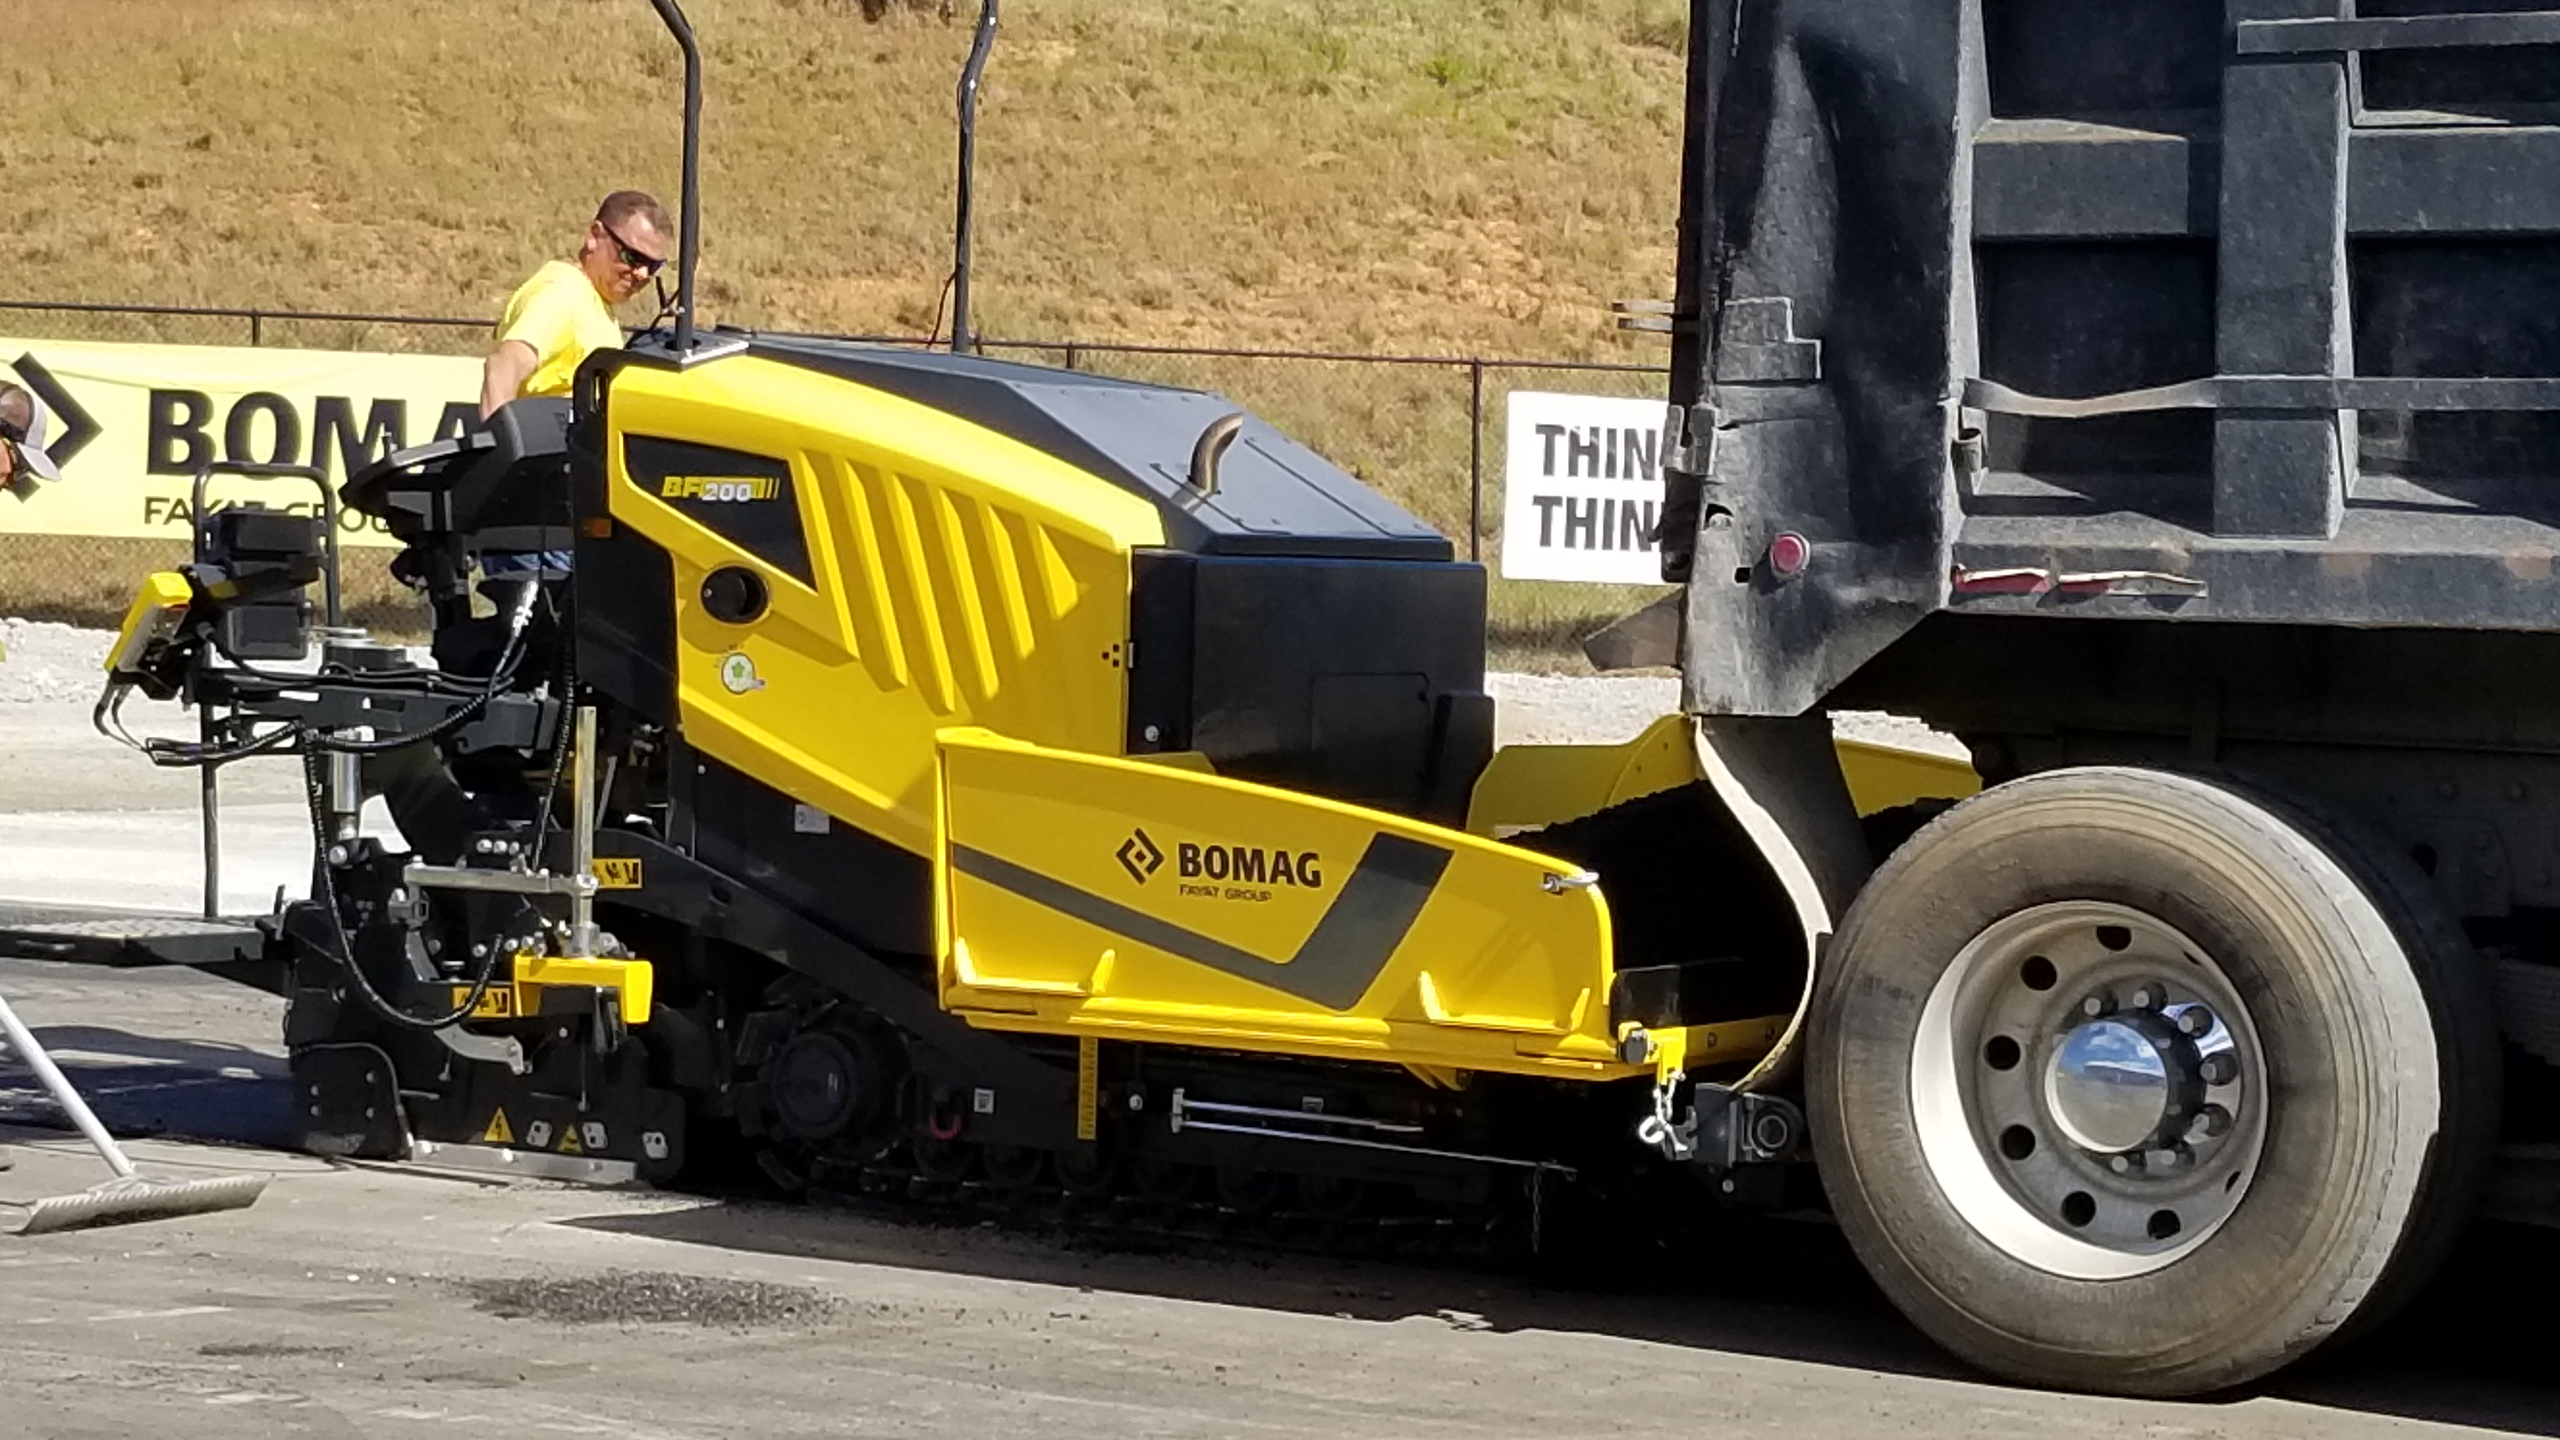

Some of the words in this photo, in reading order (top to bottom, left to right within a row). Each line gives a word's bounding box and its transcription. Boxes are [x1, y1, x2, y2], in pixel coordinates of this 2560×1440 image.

[146, 387, 482, 480] BOM
[1535, 422, 1664, 481] THIN
[1532, 494, 1665, 552] THIN
[1178, 842, 1322, 888] BOMAG
[1179, 884, 1220, 898] FAYAT
[1225, 887, 1272, 902] GROUP
